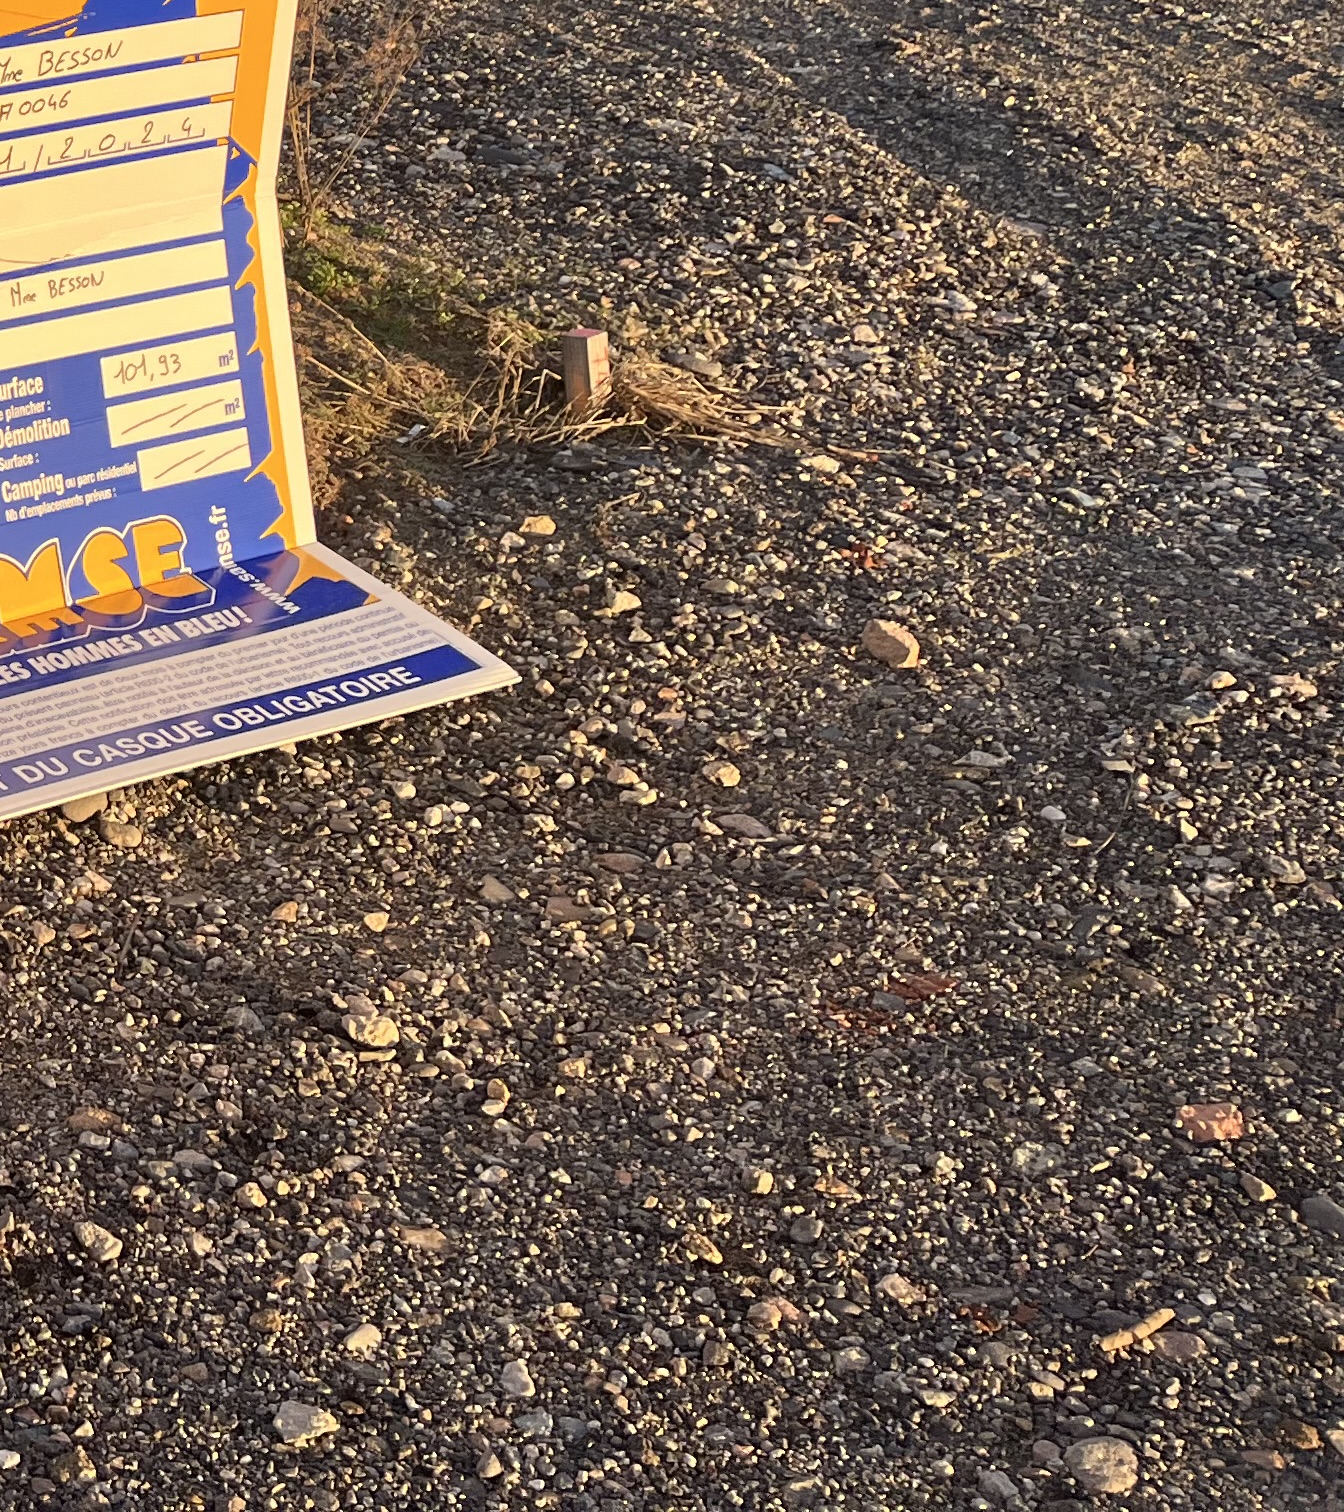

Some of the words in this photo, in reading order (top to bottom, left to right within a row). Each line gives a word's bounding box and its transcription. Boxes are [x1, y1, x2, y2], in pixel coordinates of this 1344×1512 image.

[38, 40, 123, 77] BESSON
[48, 271, 105, 299] BESSON
[1, 473, 65, 504] Camping
[65, 478, 76, 488] ou
[77, 474, 95, 490] parc
[209, 505, 301, 614] www.samse.fr
[27, 633, 143, 675] HOMMES
[144, 624, 181, 647] EN
[13, 757, 69, 784] DU
[72, 720, 213, 767] CASQUE
[213, 666, 422, 728] OBLIGATOIRE
